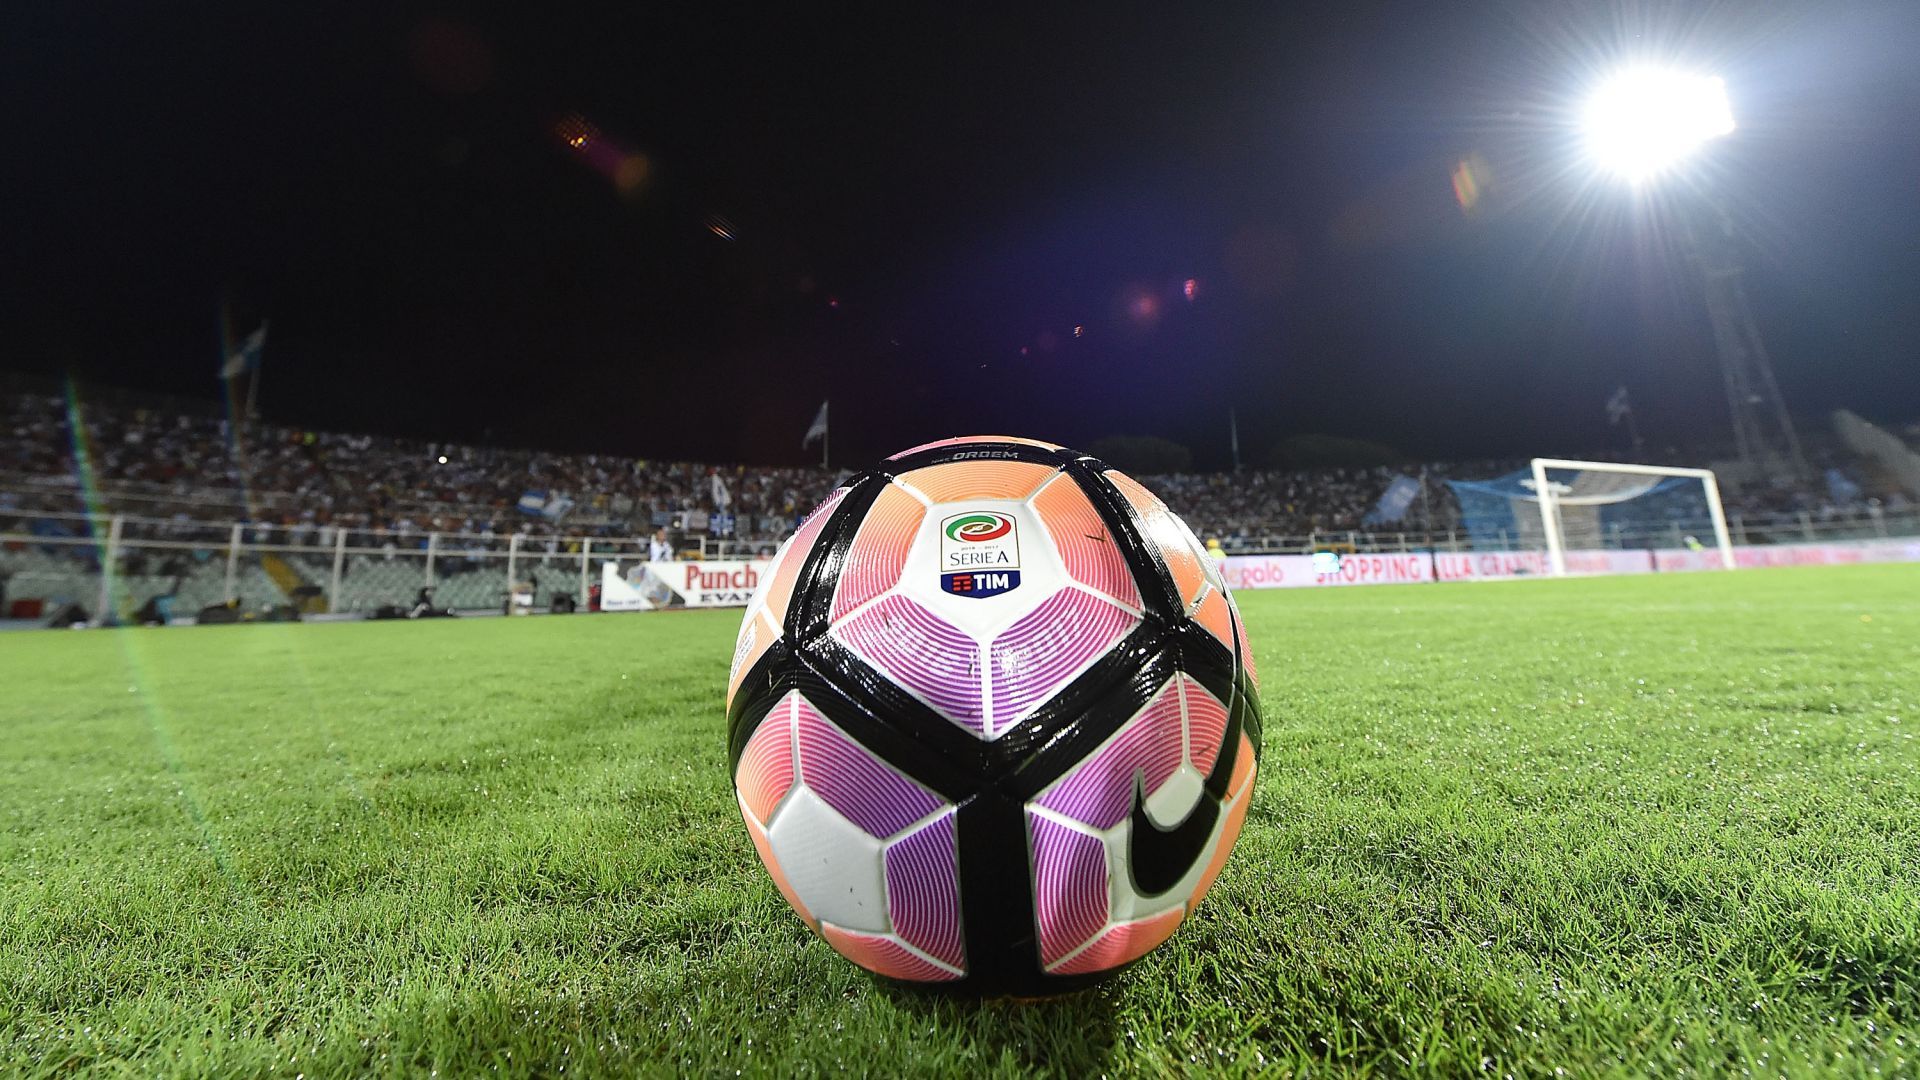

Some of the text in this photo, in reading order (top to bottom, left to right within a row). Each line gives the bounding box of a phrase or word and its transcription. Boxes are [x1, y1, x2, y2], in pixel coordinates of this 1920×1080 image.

[952, 451, 1019, 461] ORDEM
[950, 550, 1009, 566] SERIE A
[685, 564, 758, 590] Punch
[973, 573, 1010, 590] TIM
